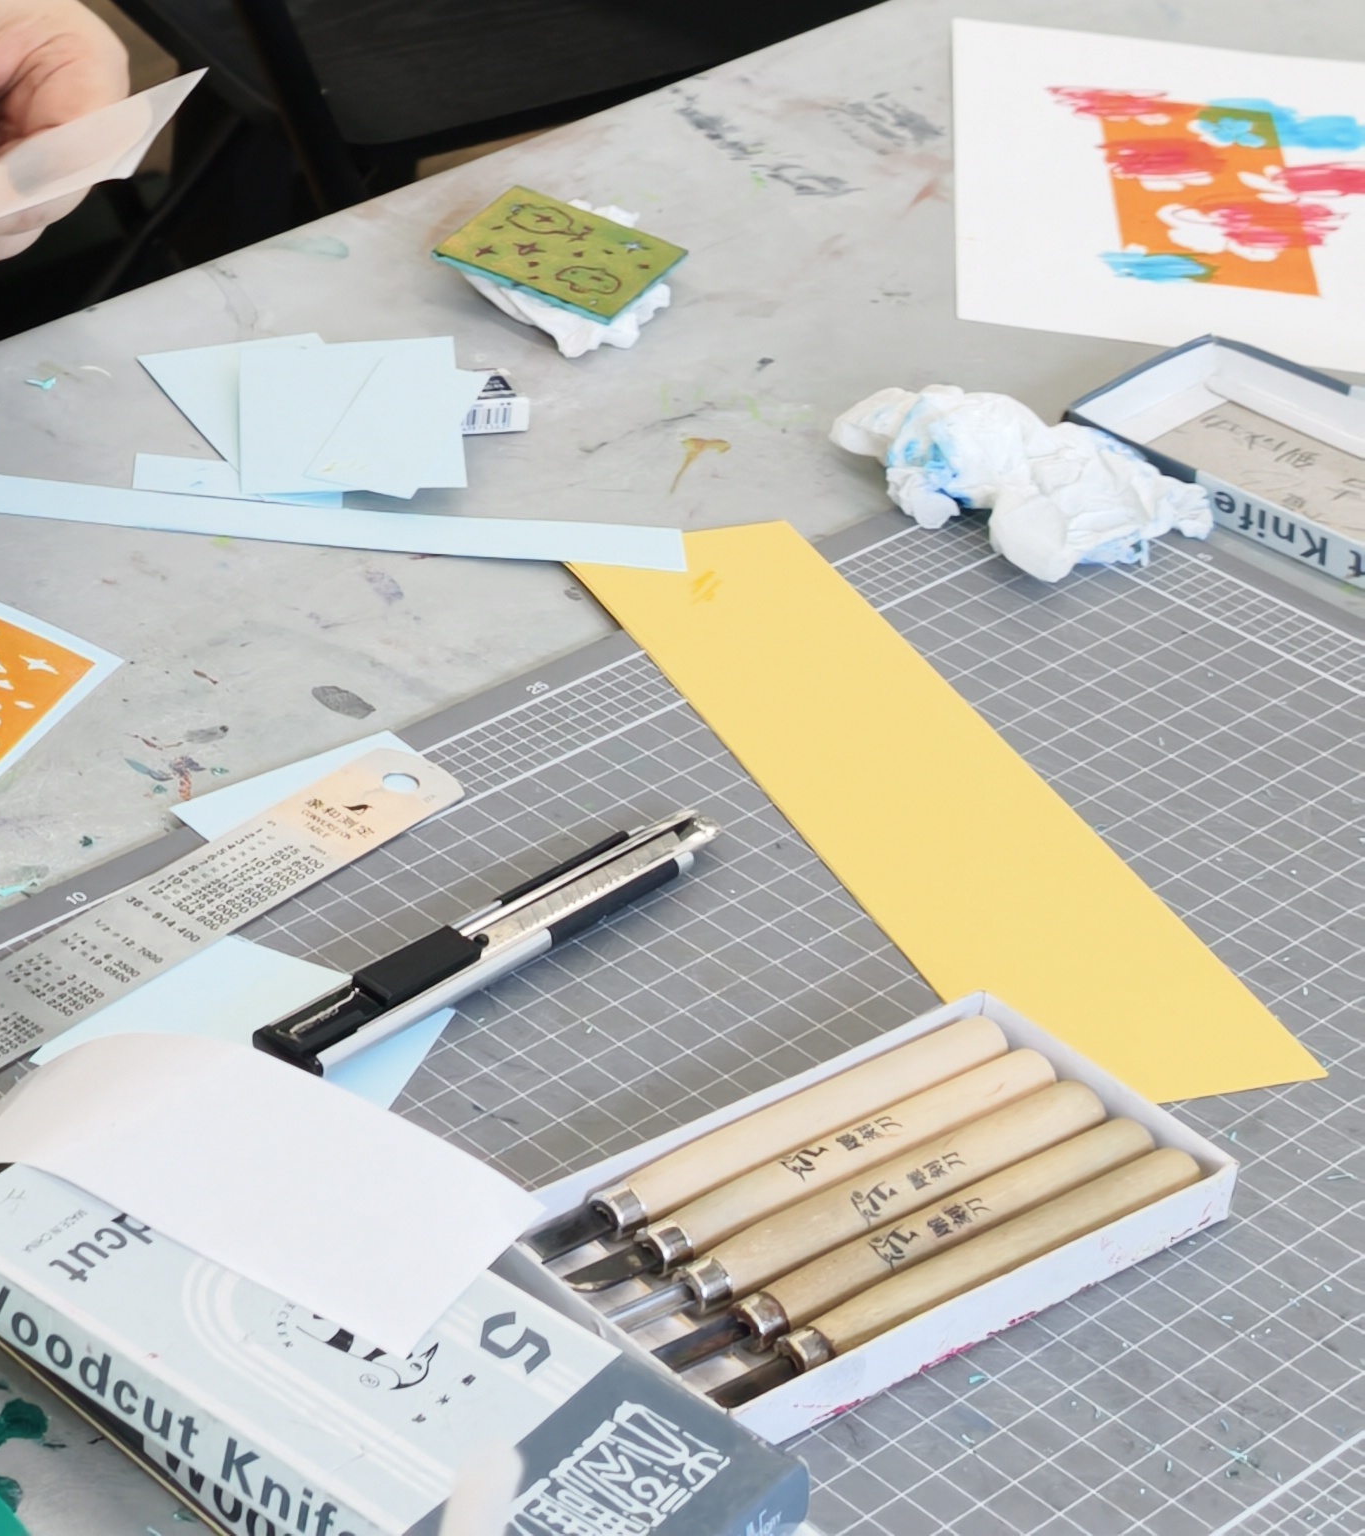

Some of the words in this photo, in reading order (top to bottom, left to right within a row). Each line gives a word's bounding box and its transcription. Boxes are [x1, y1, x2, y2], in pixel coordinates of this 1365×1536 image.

[1214, 491, 1328, 566] Knife
[66, 891, 87, 905] 10
[151, 911, 201, 942] 914.400
[480, 1311, 551, 1375] 5
